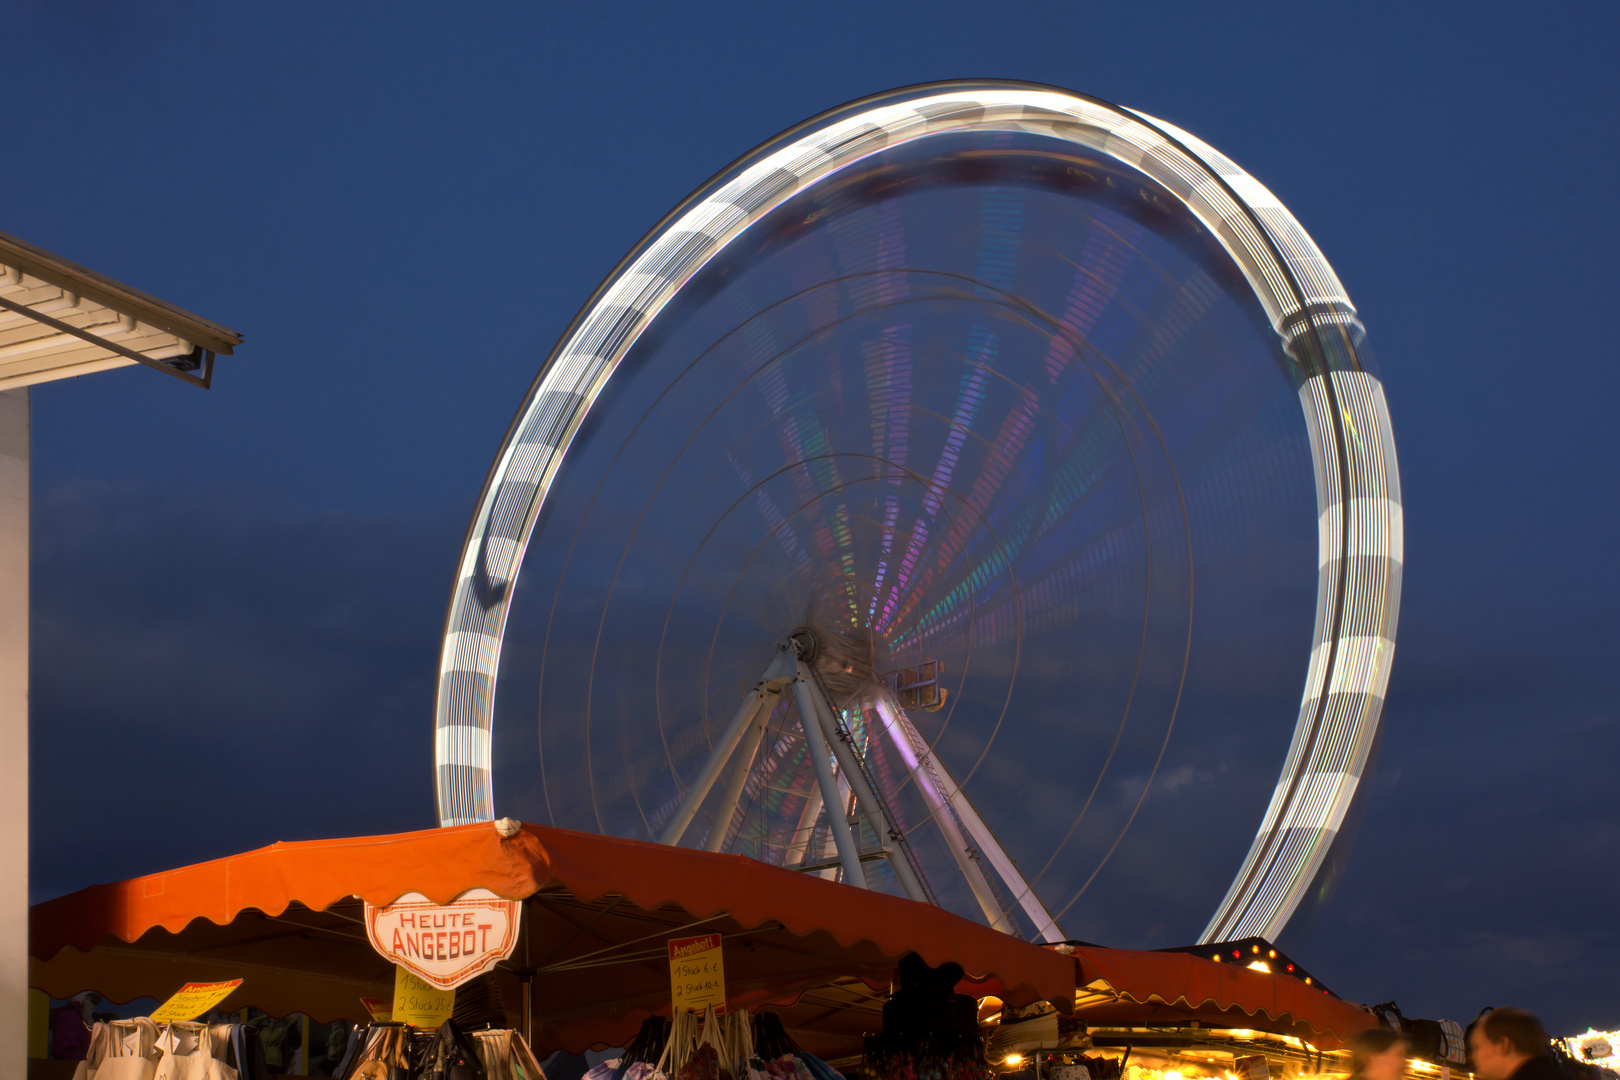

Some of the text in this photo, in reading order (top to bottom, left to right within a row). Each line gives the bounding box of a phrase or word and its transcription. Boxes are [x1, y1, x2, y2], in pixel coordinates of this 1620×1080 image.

[400, 912, 476, 929] HEUTE
[392, 923, 493, 961] ANGEBOT
[674, 936, 713, 957] Angebot!
[674, 966, 681, 978] 1
[183, 981, 233, 993] Angebot!
[400, 974, 409, 990] 1
[676, 985, 683, 997] 2
[398, 996, 406, 1012] 2
